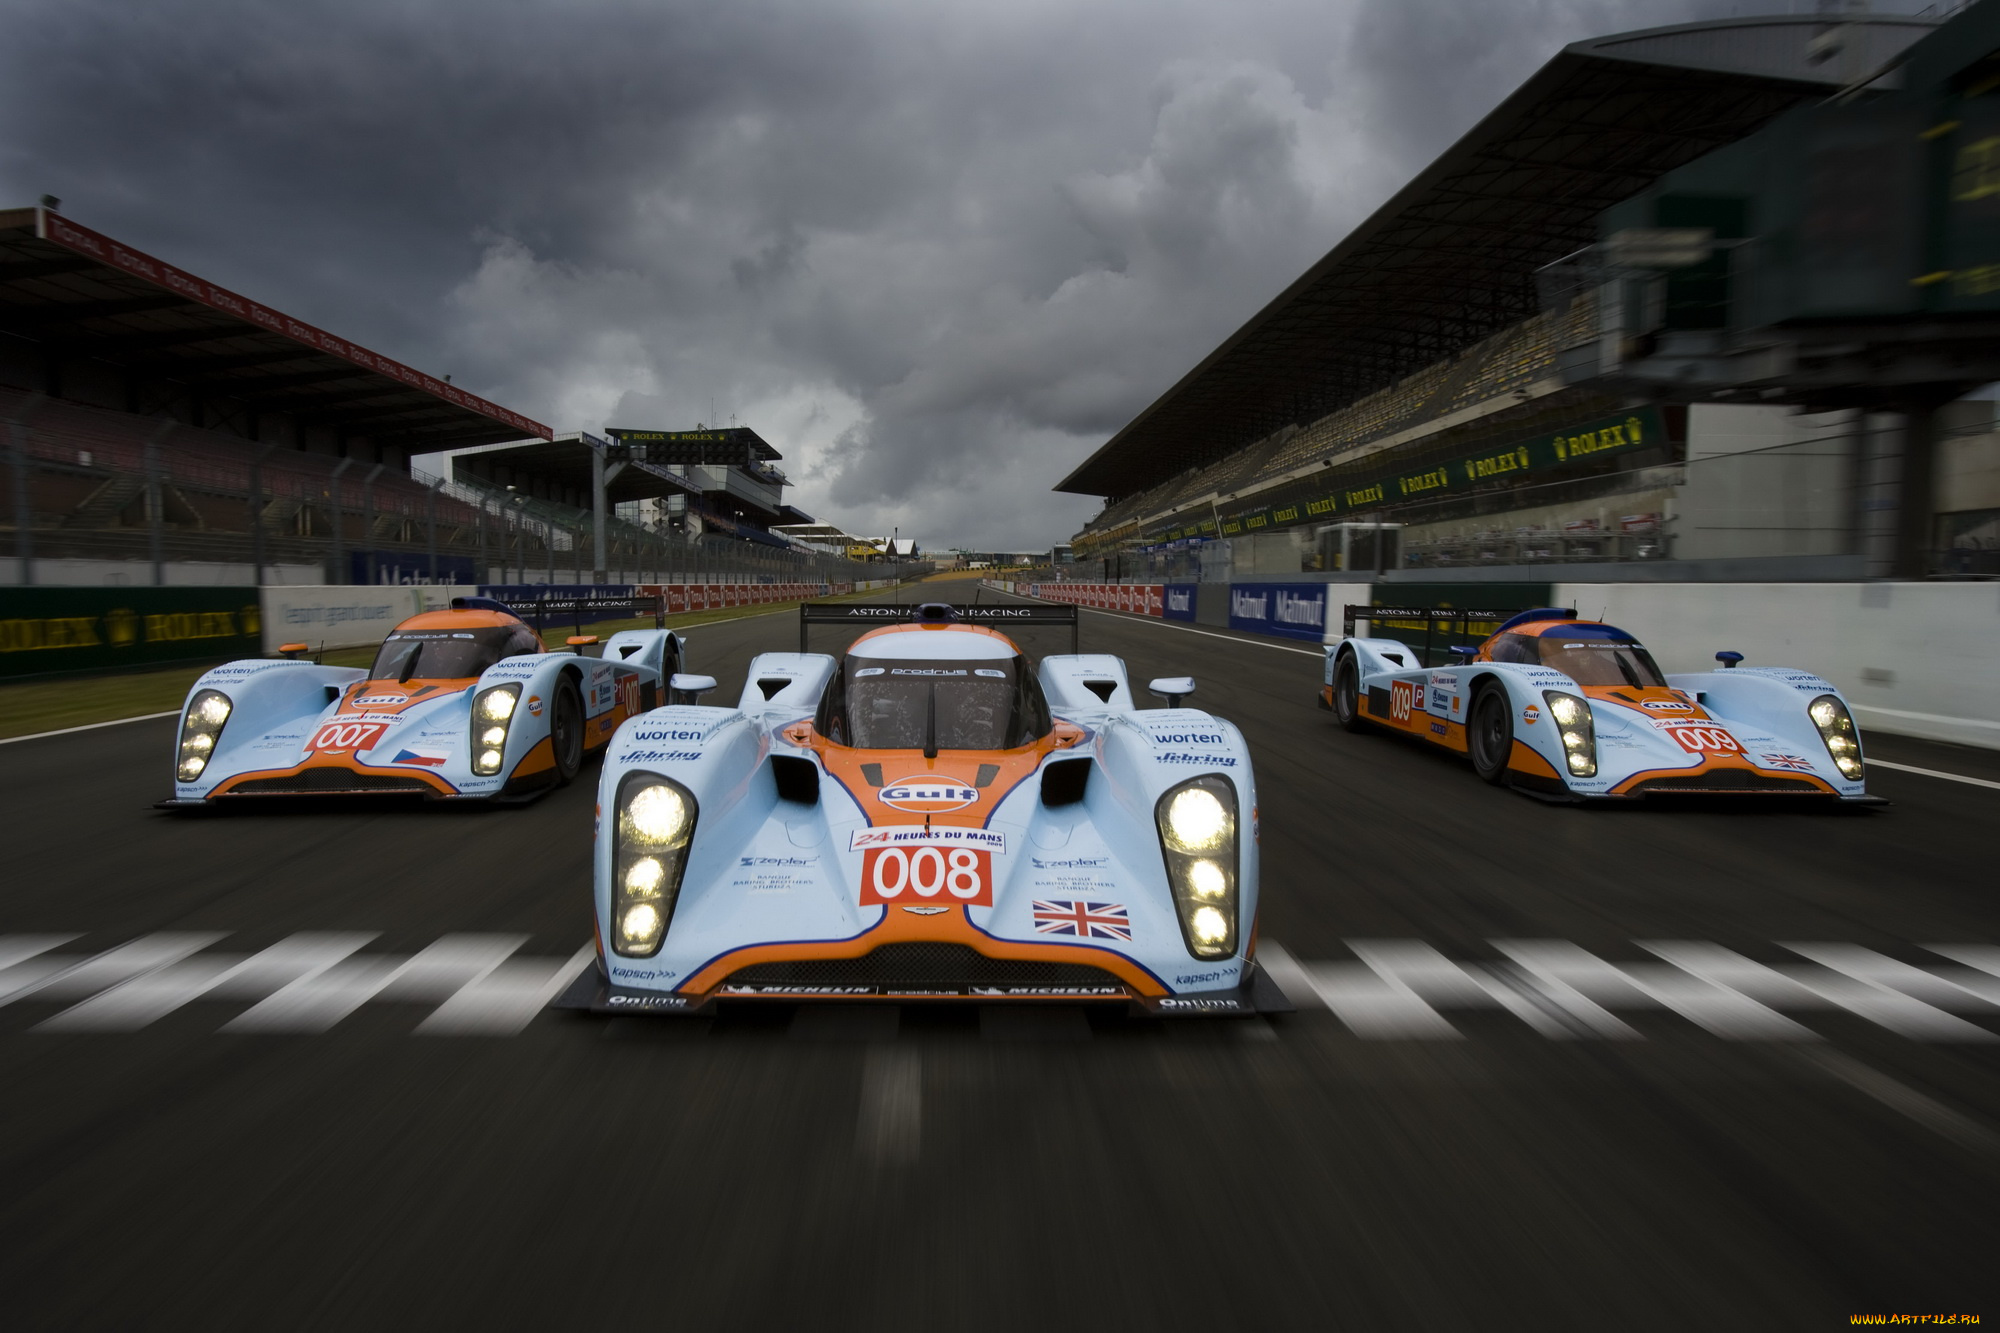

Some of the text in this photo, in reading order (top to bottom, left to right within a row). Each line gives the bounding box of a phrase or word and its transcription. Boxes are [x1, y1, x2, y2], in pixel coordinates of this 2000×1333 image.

[681, 433, 713, 441] ROLEX
[1276, 508, 1294, 522] ROLEX
[1310, 500, 1332, 514] ROLEX
[1351, 487, 1377, 505] ROLEX
[1407, 472, 1440, 492] ROLEX
[1475, 452, 1519, 478] ROLEX
[1568, 425, 1627, 457] ROLEX
[1168, 588, 1190, 612] Matmut
[849, 608, 900, 616] ASTON
[969, 609, 1031, 617] RACING
[1231, 589, 1324, 626] Matmut Matmut
[497, 661, 535, 669] worten
[891, 668, 968, 676] prodrive
[625, 680, 638, 716] 007
[1392, 686, 1410, 721] 009
[528, 702, 543, 711] Gulf
[1644, 702, 1692, 710] Gulf
[1523, 710, 1540, 719] Gulf
[316, 724, 381, 748] 007
[635, 730, 701, 740] worten
[1155, 733, 1223, 743] worten
[1676, 728, 1738, 751] 009
[619, 750, 703, 761] Sebring
[1154, 752, 1239, 767] Sebring
[458, 780, 486, 788] kapsch
[881, 787, 976, 800] Gulf
[853, 831, 891, 847] 24
[893, 831, 941, 841] HEURES
[966, 832, 1003, 842] MANS
[757, 857, 807, 866] zepler
[1049, 857, 1097, 868] zepler
[873, 847, 981, 899] 008
[612, 966, 655, 980] kapsch
[1175, 972, 1220, 985] kapsch
[762, 986, 871, 994] MICHELIN
[1008, 986, 1117, 995] MICHELIN
